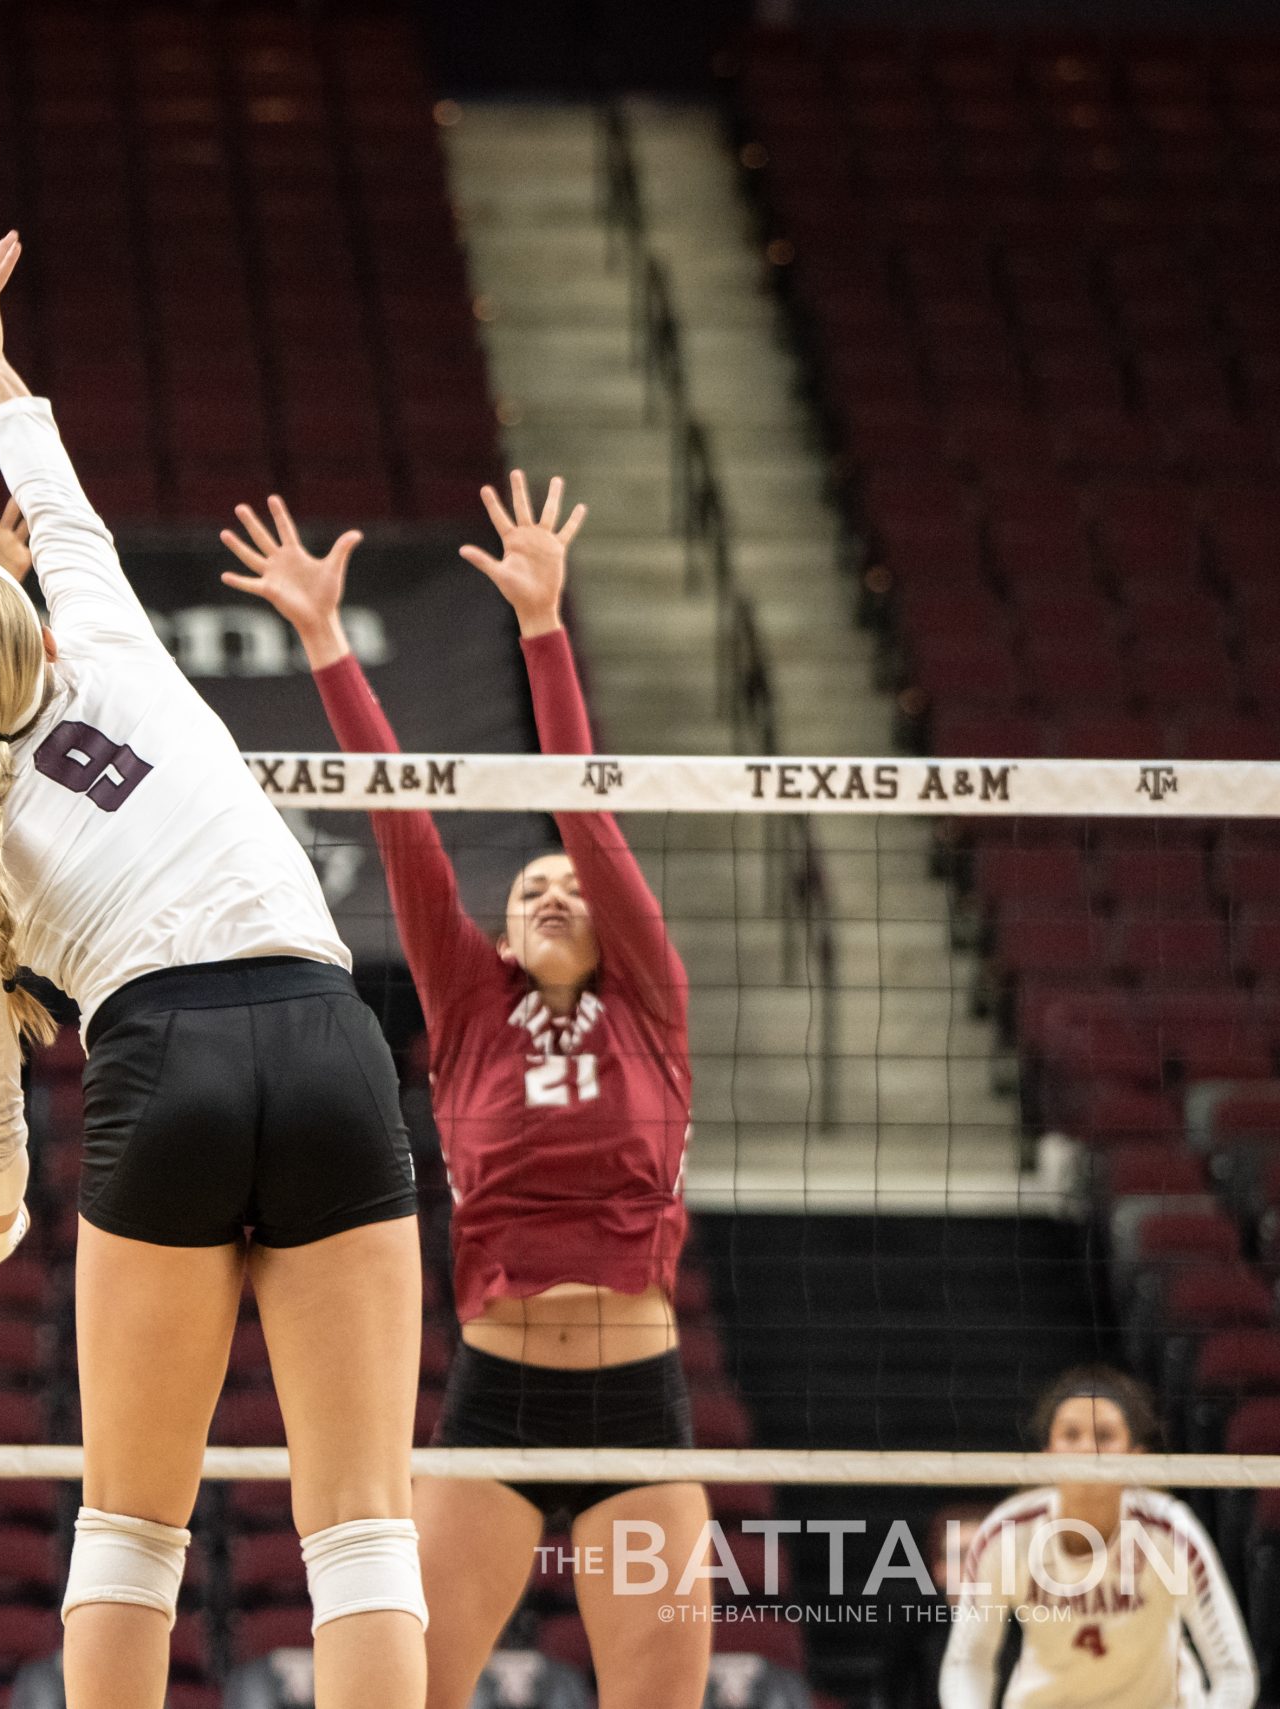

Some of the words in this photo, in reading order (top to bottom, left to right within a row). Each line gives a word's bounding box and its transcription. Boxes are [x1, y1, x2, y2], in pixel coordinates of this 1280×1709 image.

[33, 719, 154, 813] 9
[243, 759, 346, 794] XAS
[366, 760, 458, 796] A&M
[746, 764, 899, 799] TEXAS
[918, 766, 1011, 801] A&M
[524, 1053, 599, 1108] 21
[1072, 1624, 1107, 1658] 4
